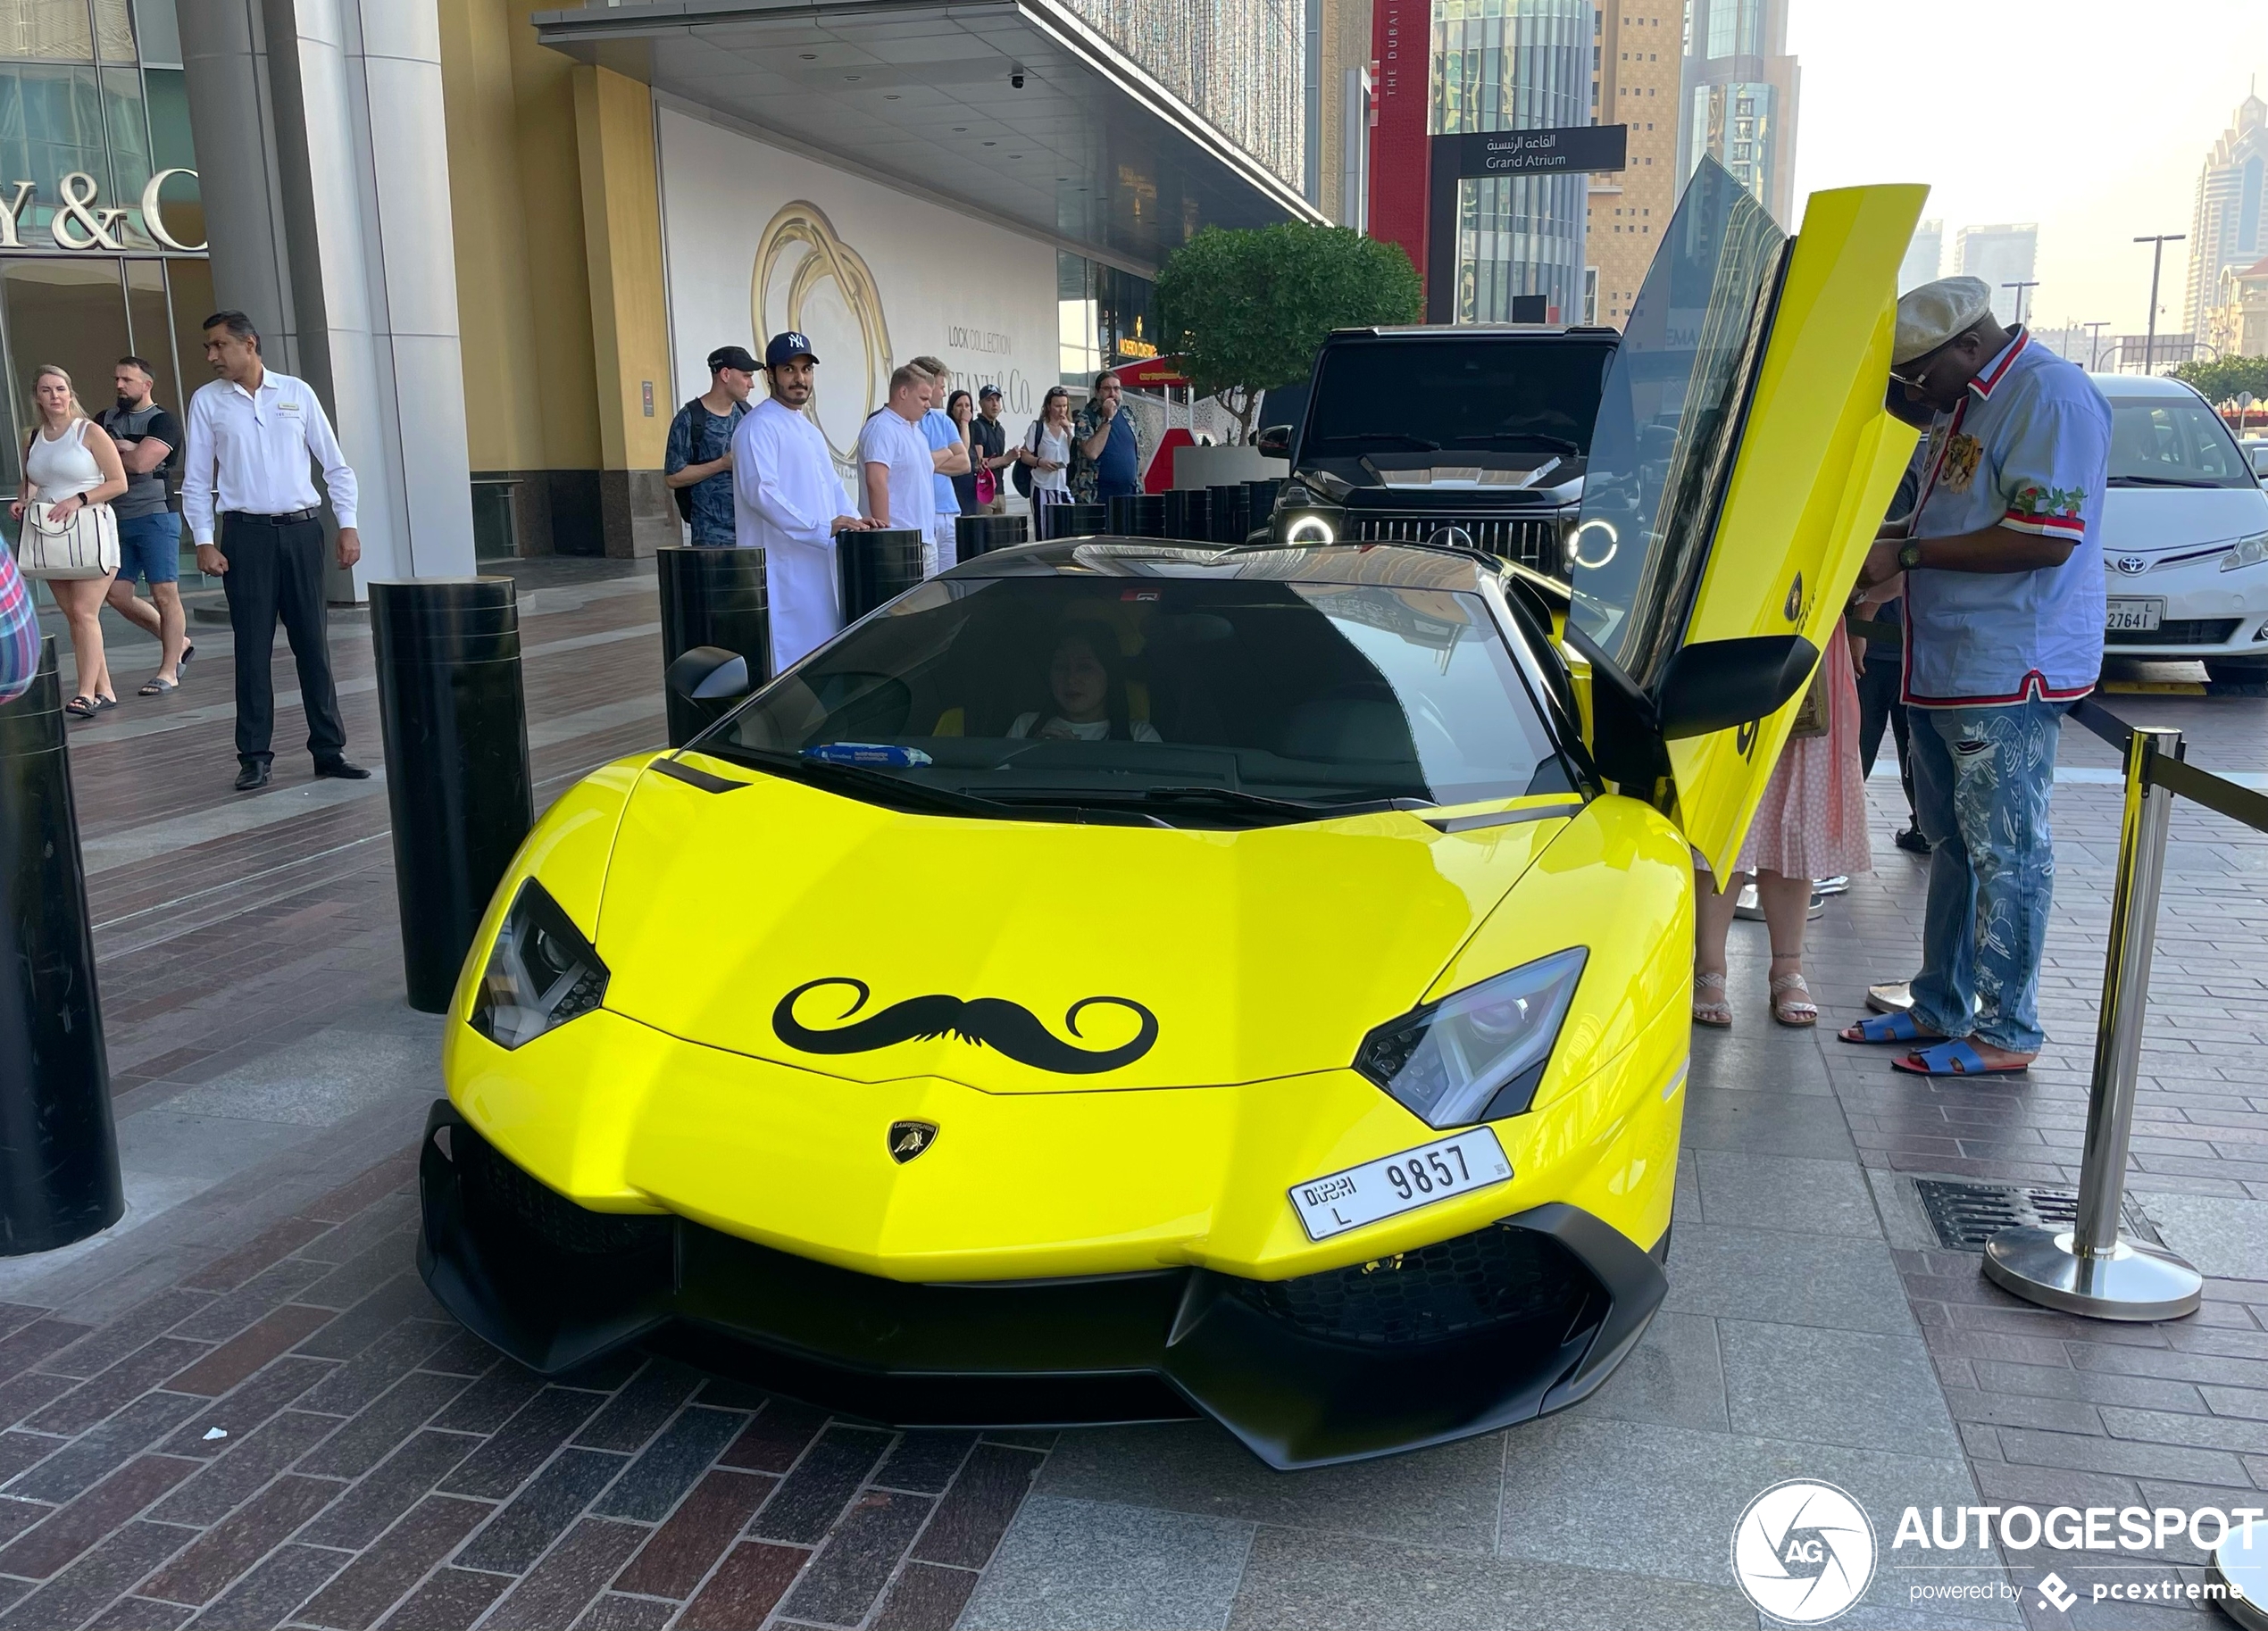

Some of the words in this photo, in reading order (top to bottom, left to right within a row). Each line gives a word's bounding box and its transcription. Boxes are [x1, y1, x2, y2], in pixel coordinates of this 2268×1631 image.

[1388, 11, 1398, 60] DUBAI
[1387, 69, 1397, 96] THE
[1487, 136, 1523, 154] الرئيسية
[1525, 134, 1555, 149] القاعة
[1486, 155, 1522, 169] Grand
[1525, 154, 1566, 167] Atrium
[52, 171, 127, 250] &
[788, 333, 805, 348] NY
[949, 325, 969, 349] LOCK
[970, 329, 1012, 355] COLLECTION
[1009, 369, 1032, 414] Co.
[2145, 603, 2153, 612] L
[2107, 613, 2147, 628] 27641
[1386, 1144, 1470, 1200] 9857
[1331, 1208, 1352, 1226] L
